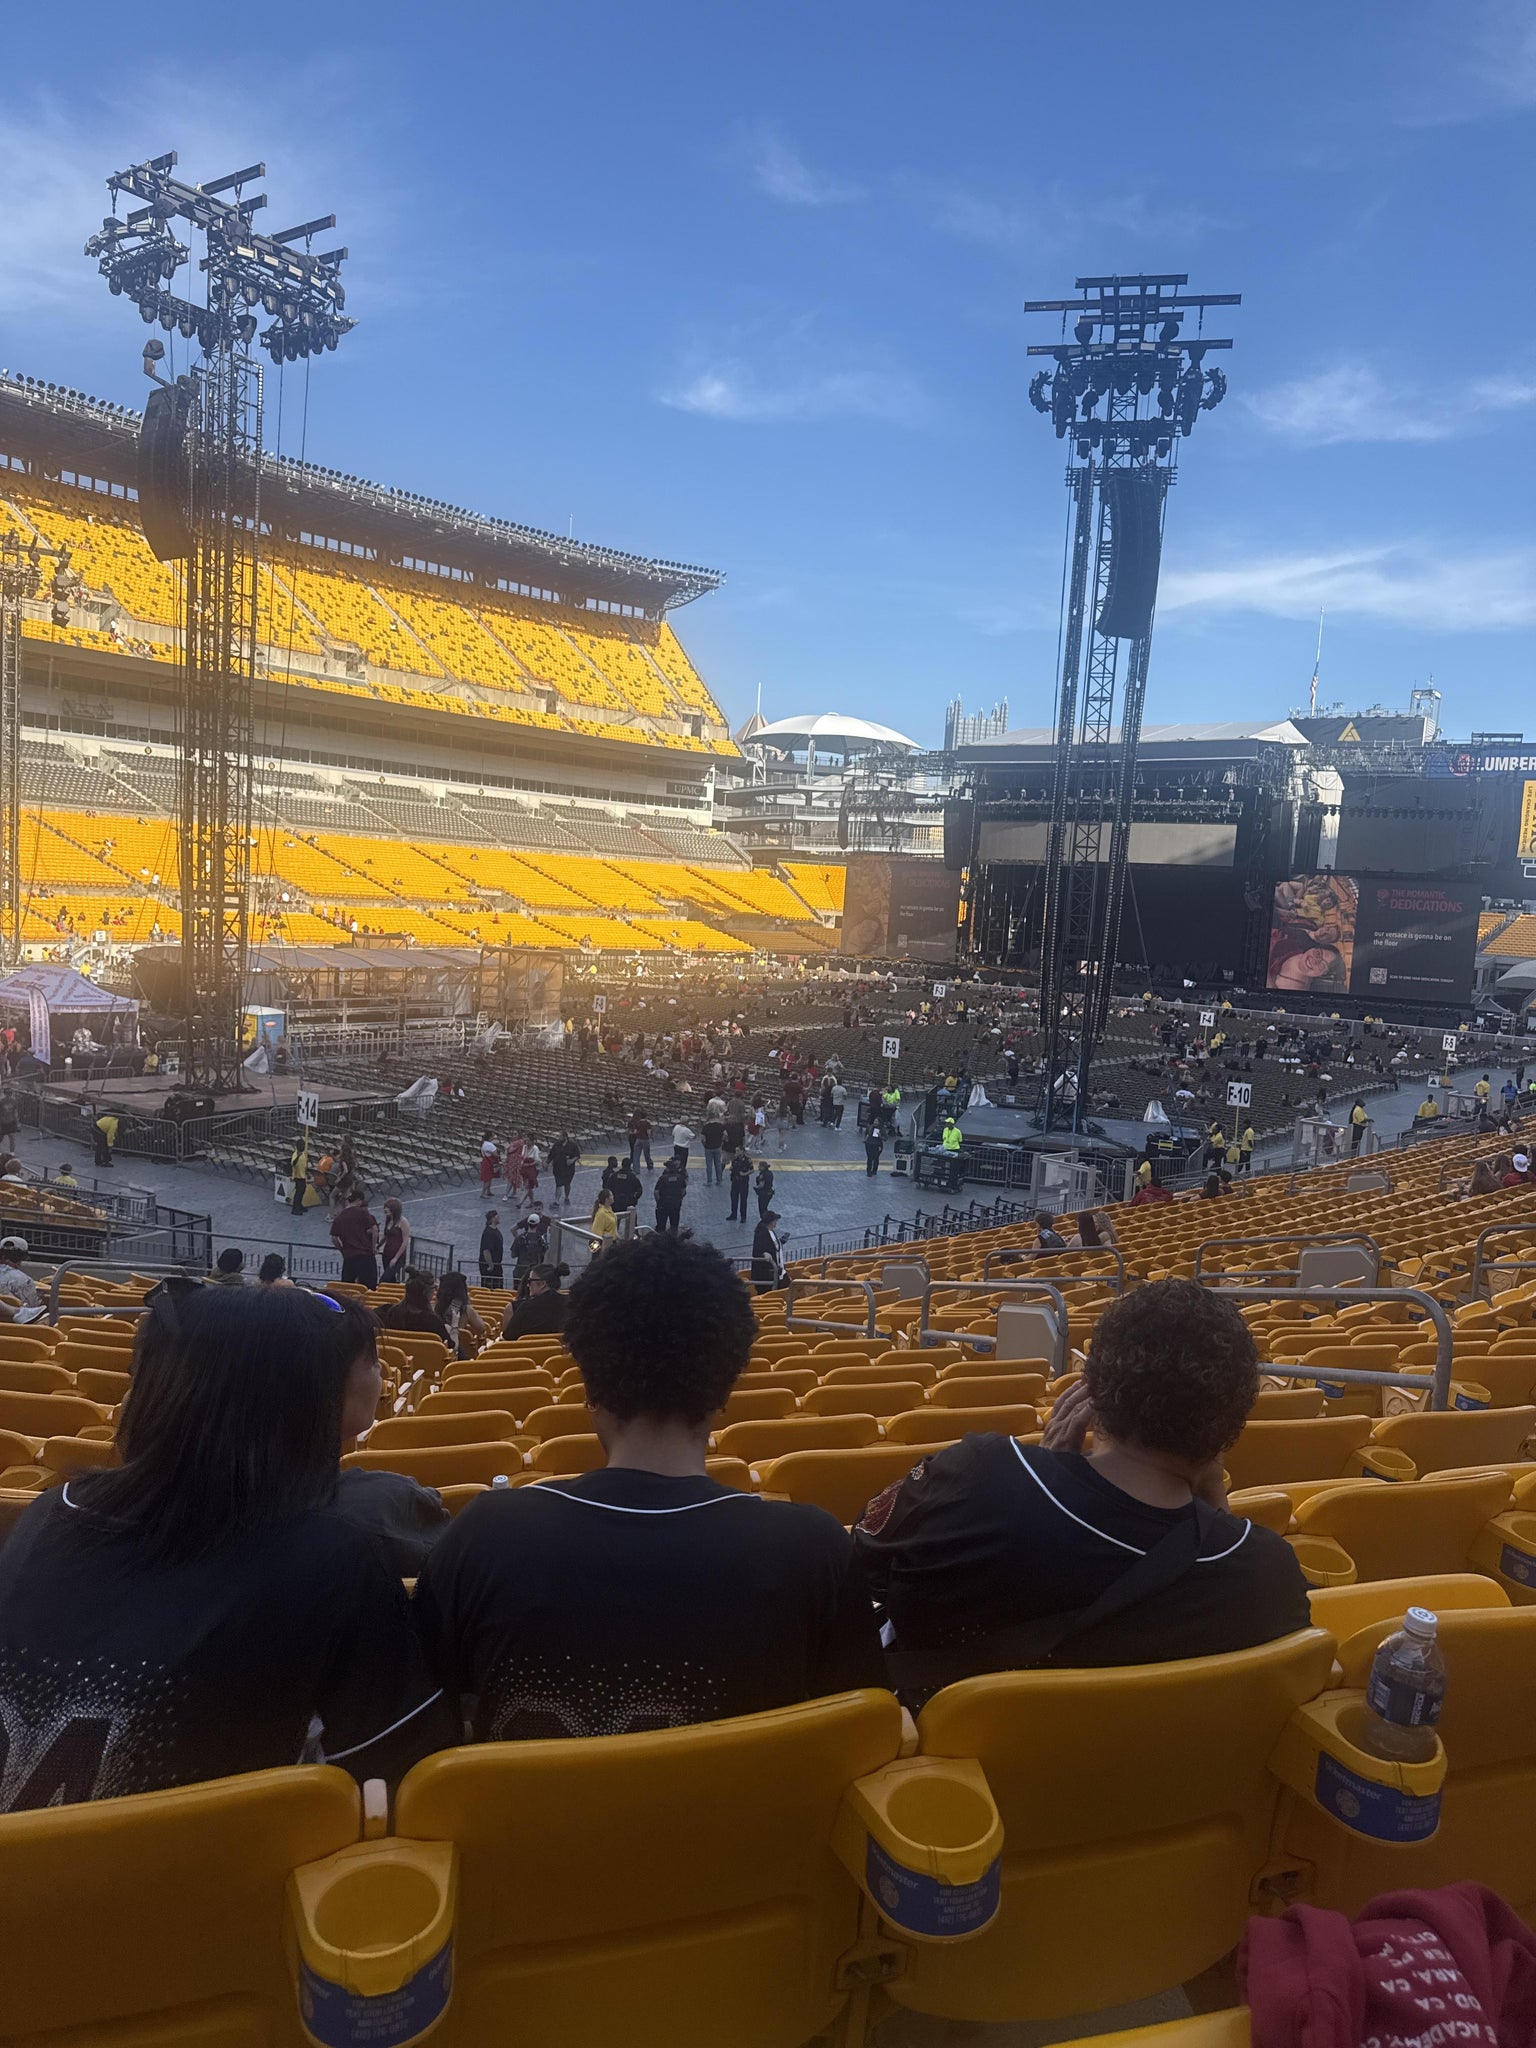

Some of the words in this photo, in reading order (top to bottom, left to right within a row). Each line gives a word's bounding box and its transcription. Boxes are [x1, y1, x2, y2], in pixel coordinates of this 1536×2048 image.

[674, 784, 701, 796] UPMC
[1390, 898, 1464, 912] DEDICATIONS
[934, 985, 944, 996] F-3
[1202, 1014, 1212, 1025] F-4
[885, 1040, 897, 1055] F-9
[1444, 1037, 1454, 1049] F-5
[1228, 1086, 1250, 1104] F-10
[297, 1096, 317, 1122] F-14
[1412, 1968, 1460, 1985] ARA,
[1379, 1977, 1411, 1993] CA
[1414, 1996, 1446, 2011] CA
[1385, 2020, 1481, 2048] ACADEMY,
